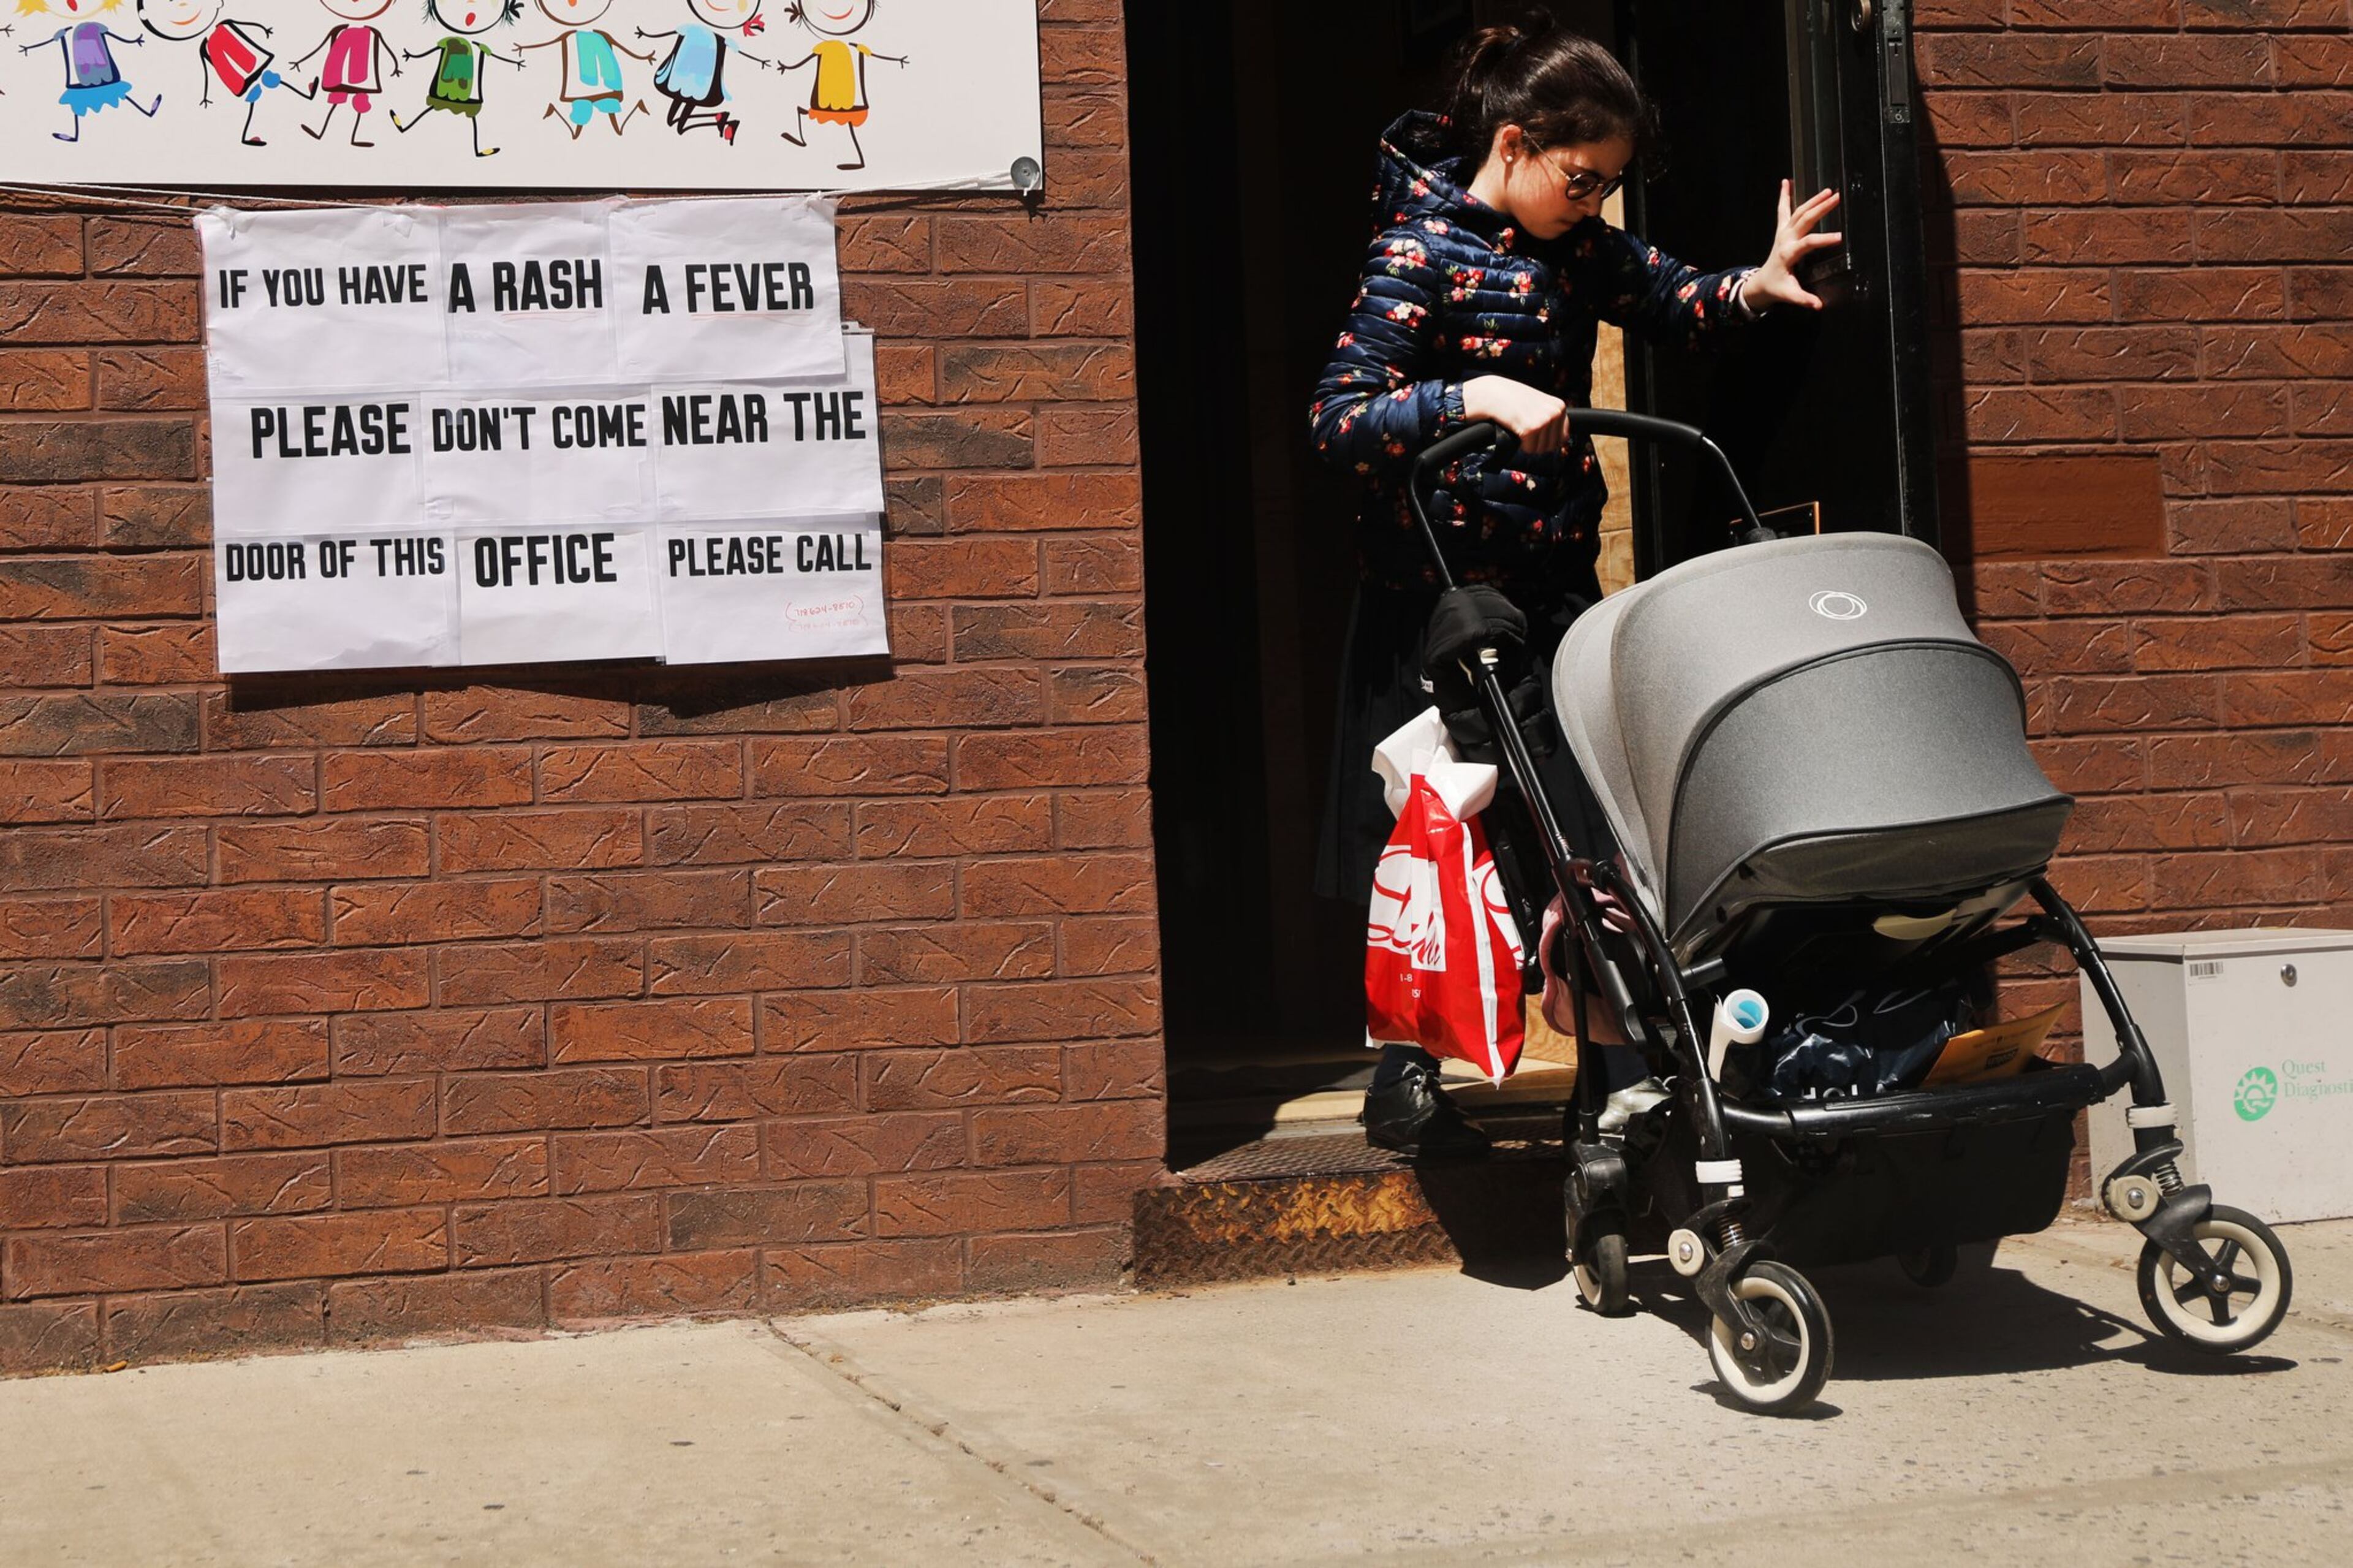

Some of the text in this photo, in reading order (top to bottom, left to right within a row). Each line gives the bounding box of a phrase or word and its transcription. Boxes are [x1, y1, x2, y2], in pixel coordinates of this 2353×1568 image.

[219, 259, 814, 314] IF YOU HAVE A RASH A FEVER
[251, 391, 866, 459] PLEASE DON'T COME NEAR THE
[225, 532, 872, 588] DOOR OF THIS OFFICE PLEASE CALL
[2282, 1059, 2326, 1078] Quest
